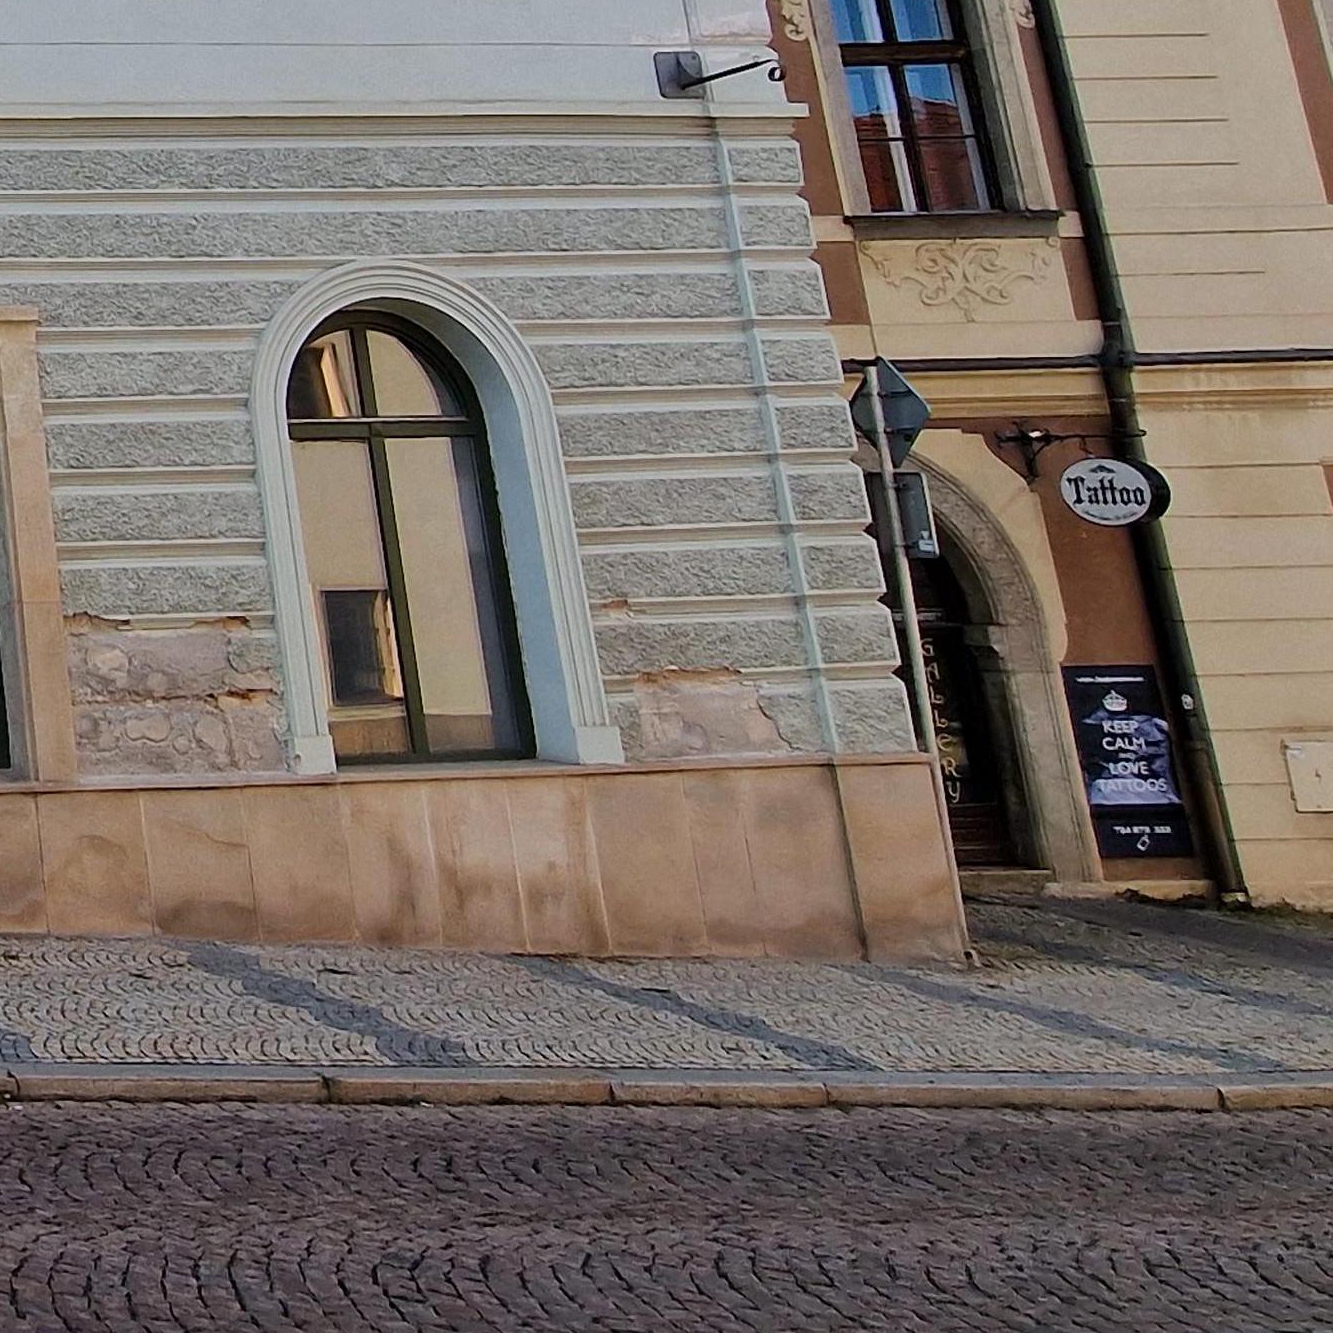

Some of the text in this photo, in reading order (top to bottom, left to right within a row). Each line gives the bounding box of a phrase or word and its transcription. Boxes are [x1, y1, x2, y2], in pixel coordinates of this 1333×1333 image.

[1066, 475, 1147, 506] Tattoo
[1102, 720, 1139, 734] KEEP
[1102, 737, 1147, 752] CALM
[1108, 761, 1149, 775] LOVE
